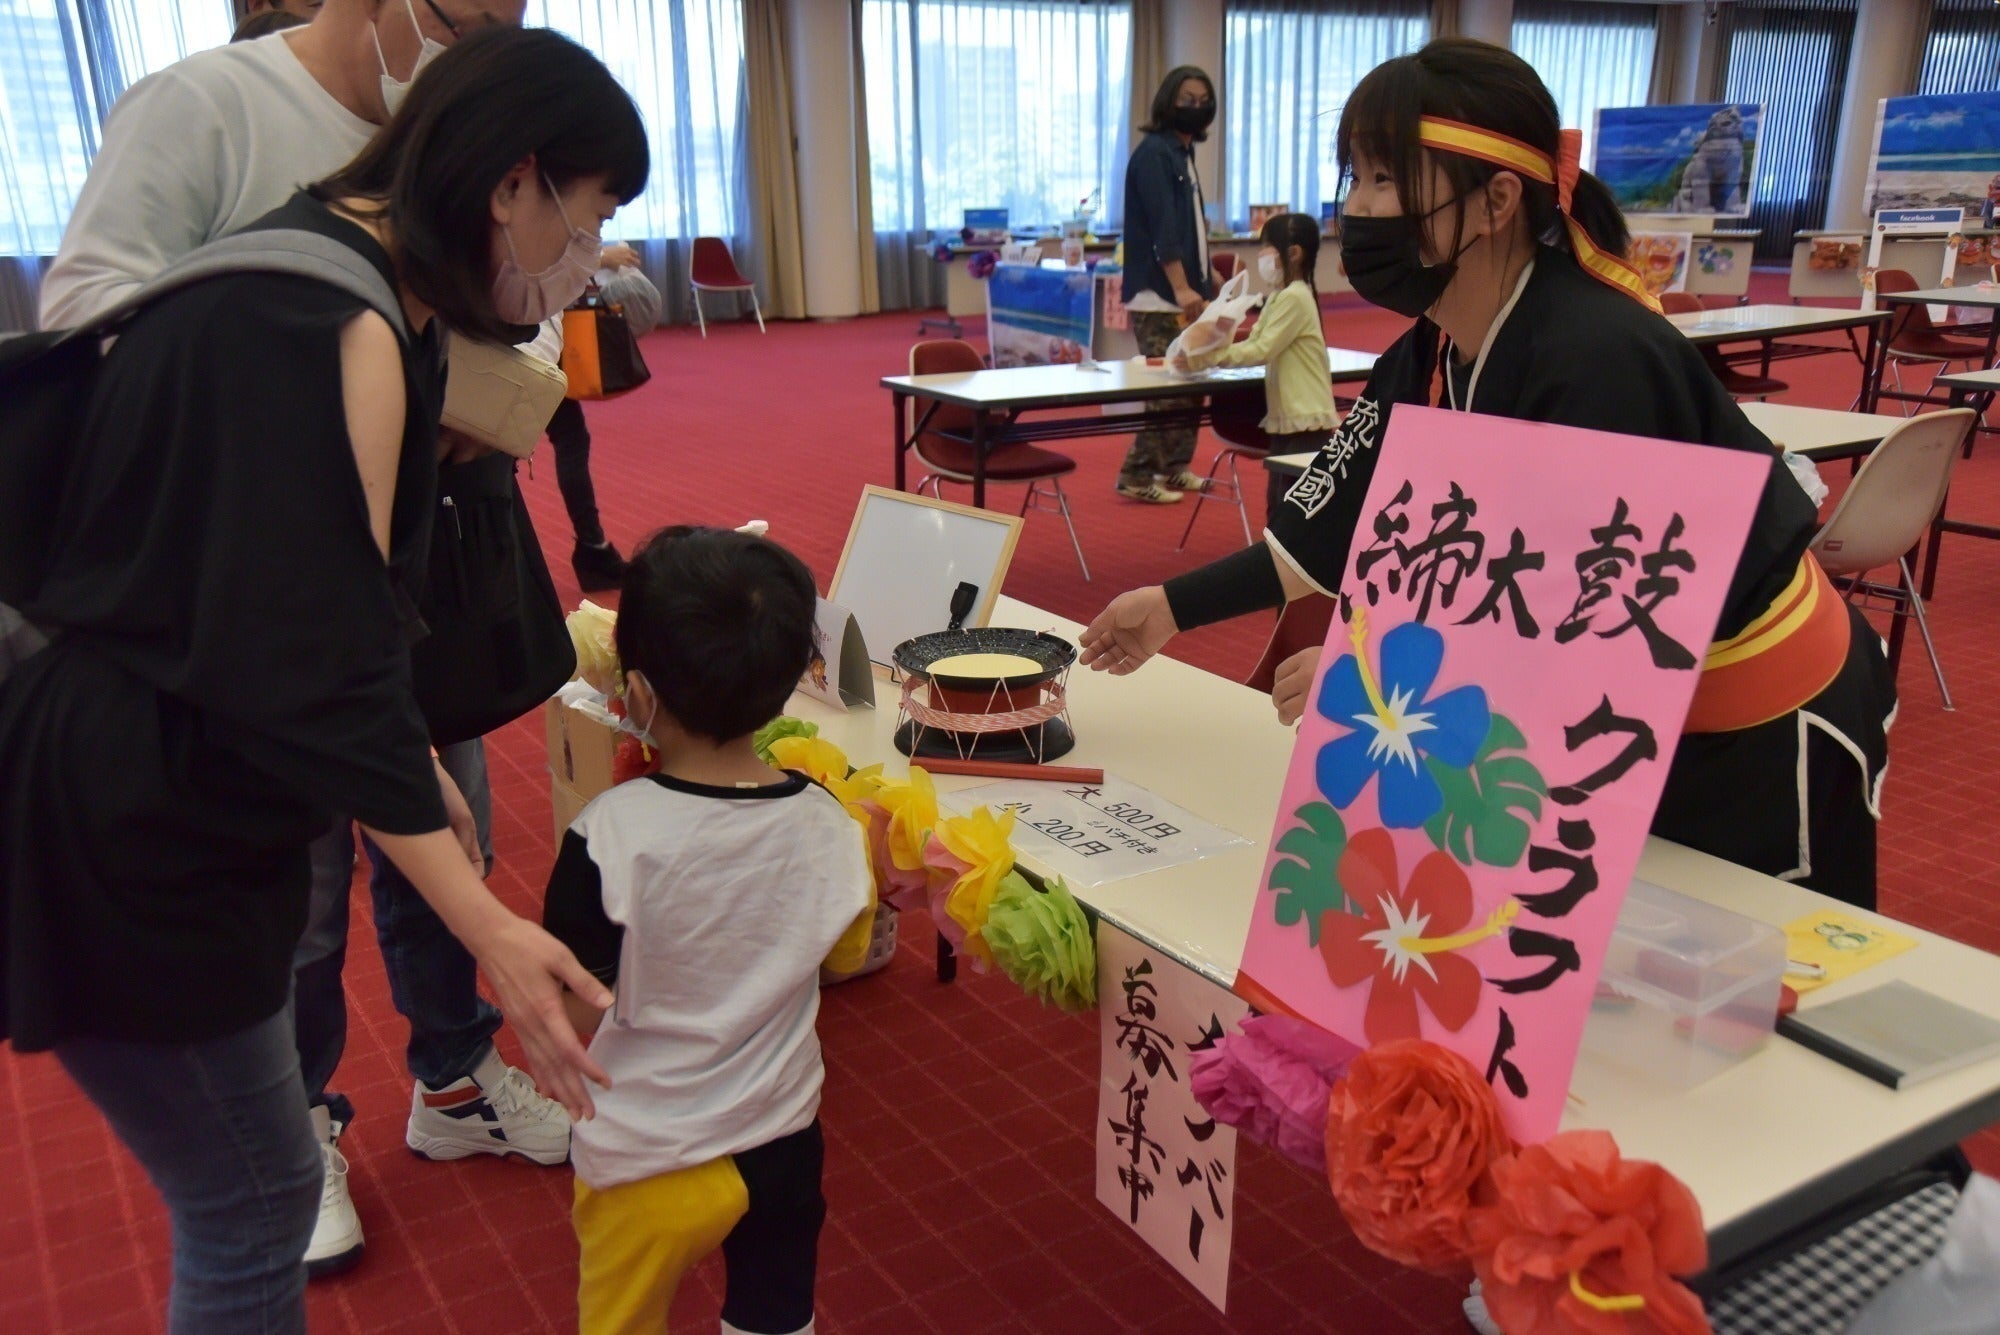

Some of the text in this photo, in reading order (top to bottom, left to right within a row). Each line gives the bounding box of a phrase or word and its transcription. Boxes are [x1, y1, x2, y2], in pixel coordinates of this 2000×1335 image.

[1899, 214, 1936, 222] facebook
[1340, 480, 1698, 670] 締太鼓
[1065, 786, 1102, 800] 大
[1485, 693, 1658, 1099] クラフト
